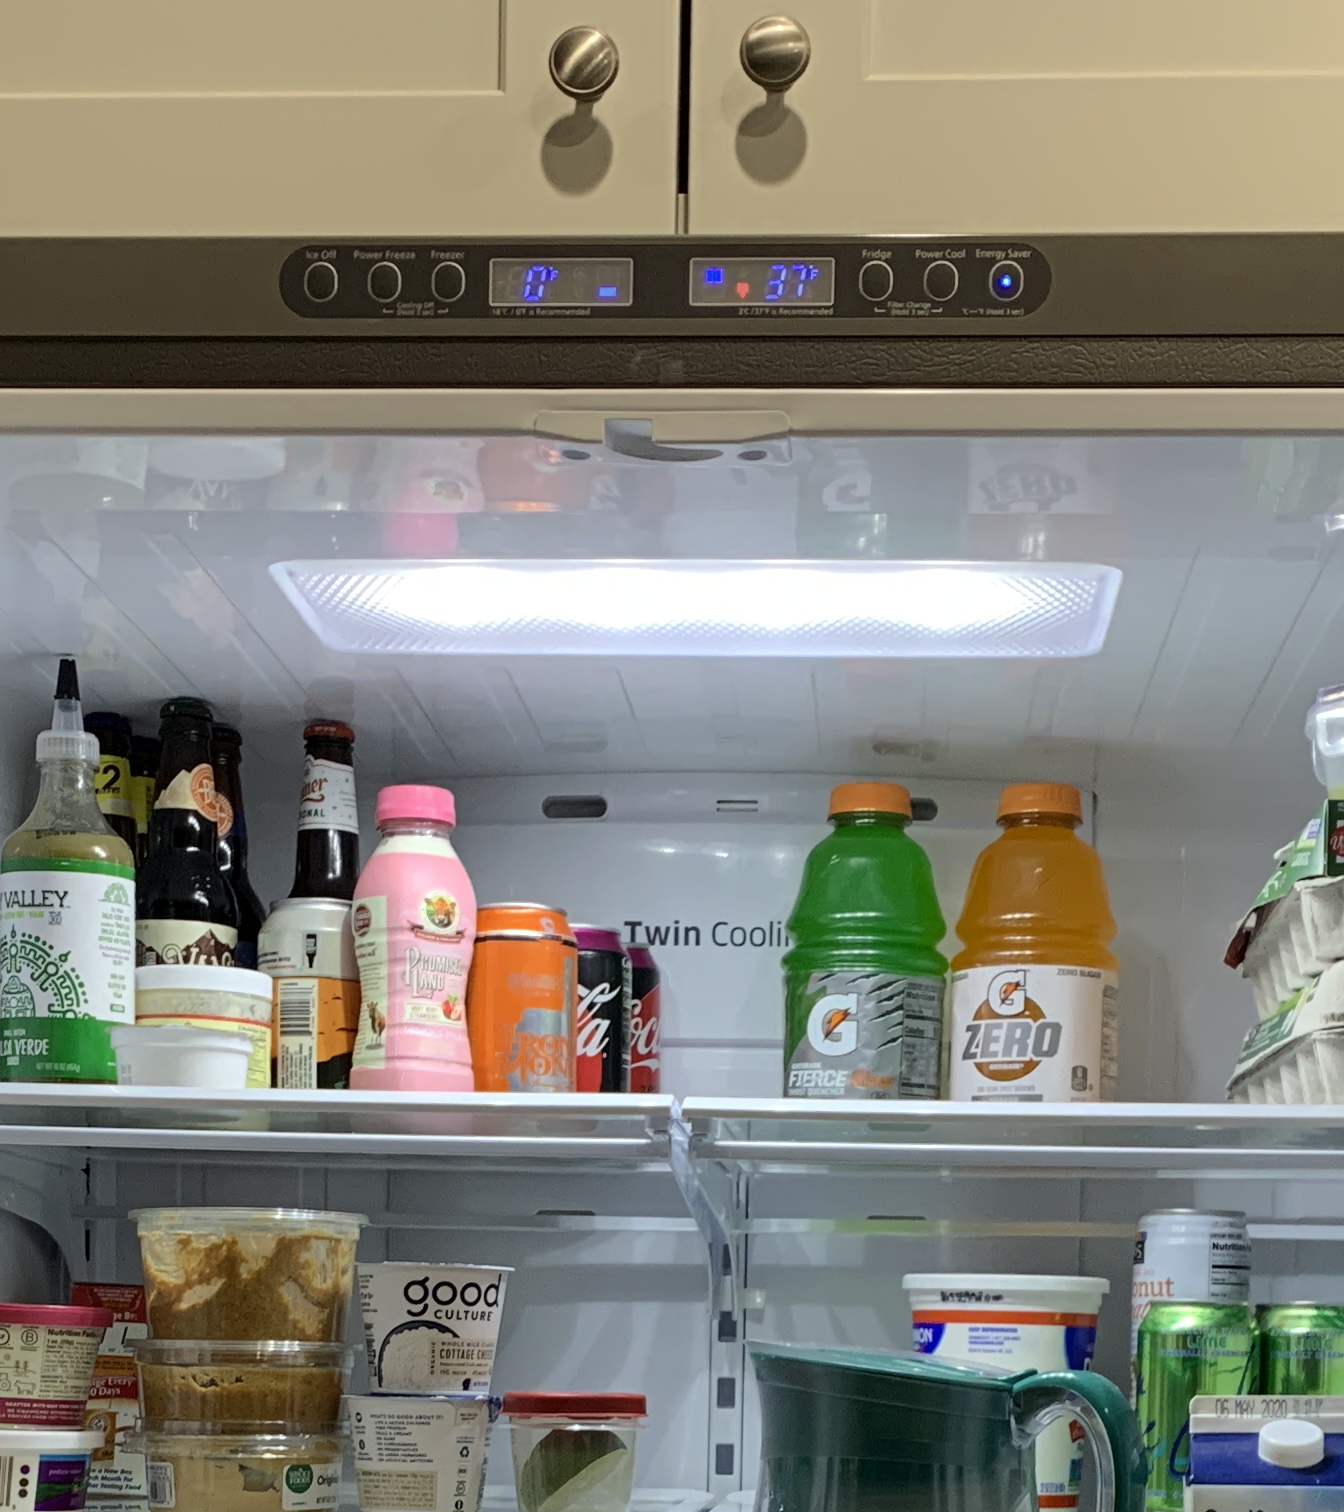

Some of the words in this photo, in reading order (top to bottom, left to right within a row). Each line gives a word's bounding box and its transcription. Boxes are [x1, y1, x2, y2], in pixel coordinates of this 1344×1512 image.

[306, 250, 318, 259] Ice
[320, 250, 337, 259] Off
[353, 250, 382, 260] Power
[386, 250, 416, 260] Freeze
[431, 250, 465, 260] Freezer
[862, 249, 892, 261] Fridge
[915, 249, 940, 259] Power
[942, 249, 966, 259] Cool
[975, 249, 1005, 261] Energy
[1007, 249, 1032, 259] Saver
[536, 307, 591, 317] Recommended
[779, 307, 834, 317] Recommended
[4, 889, 69, 909] VALLEY
[624, 920, 701, 947] Twin
[1057, 969, 1078, 977] ZERO
[1079, 971, 1102, 979] SUGAR
[987, 970, 1030, 1016] G
[807, 991, 858, 1057] G
[15, 1038, 50, 1056] VERDE
[962, 1021, 1063, 1062] ZERO
[788, 1069, 850, 1088] FIERCE
[807, 1087, 845, 1096] QUENCHER
[403, 1272, 502, 1317] good
[434, 1309, 492, 1322] CULTURE
[47, 1328, 80, 1338] Nutrition
[1186, 1334, 1228, 1350] Lime
[439, 1348, 475, 1360] COTTAGE
[108, 1377, 134, 1389] Every
[98, 1387, 121, 1398] Days
[1215, 1400, 1230, 1417] 06
[1233, 1400, 1257, 1418] MAY
[1261, 1400, 1289, 1418] 2020
[100, 1483, 123, 1492] Tasting
[124, 1483, 142, 1491] Food
